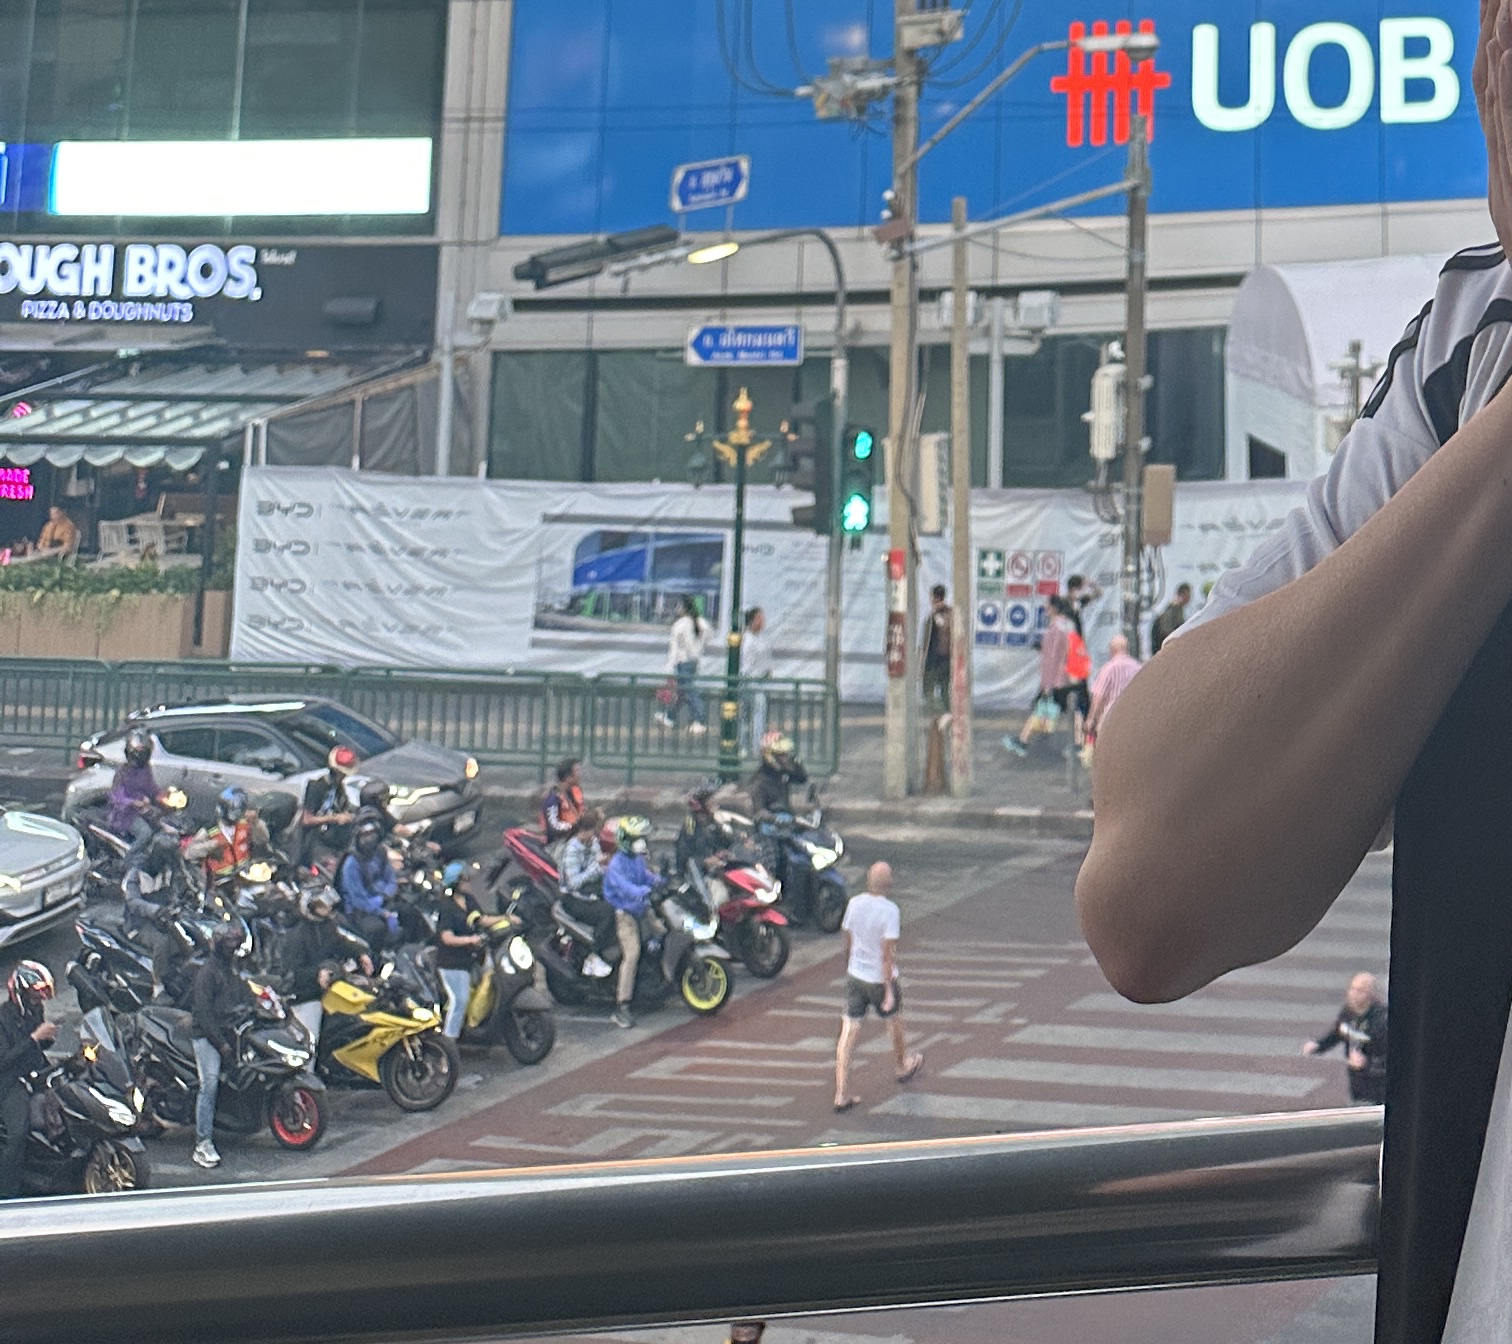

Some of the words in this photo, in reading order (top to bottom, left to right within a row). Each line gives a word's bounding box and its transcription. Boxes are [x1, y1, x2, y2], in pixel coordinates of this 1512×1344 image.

[1192, 17, 1460, 132] UOB
[123, 243, 263, 301] BROS.
[21, 300, 70, 320] PIZZA
[73, 300, 86, 320] &
[88, 300, 194, 323] DOUGHNUTS
